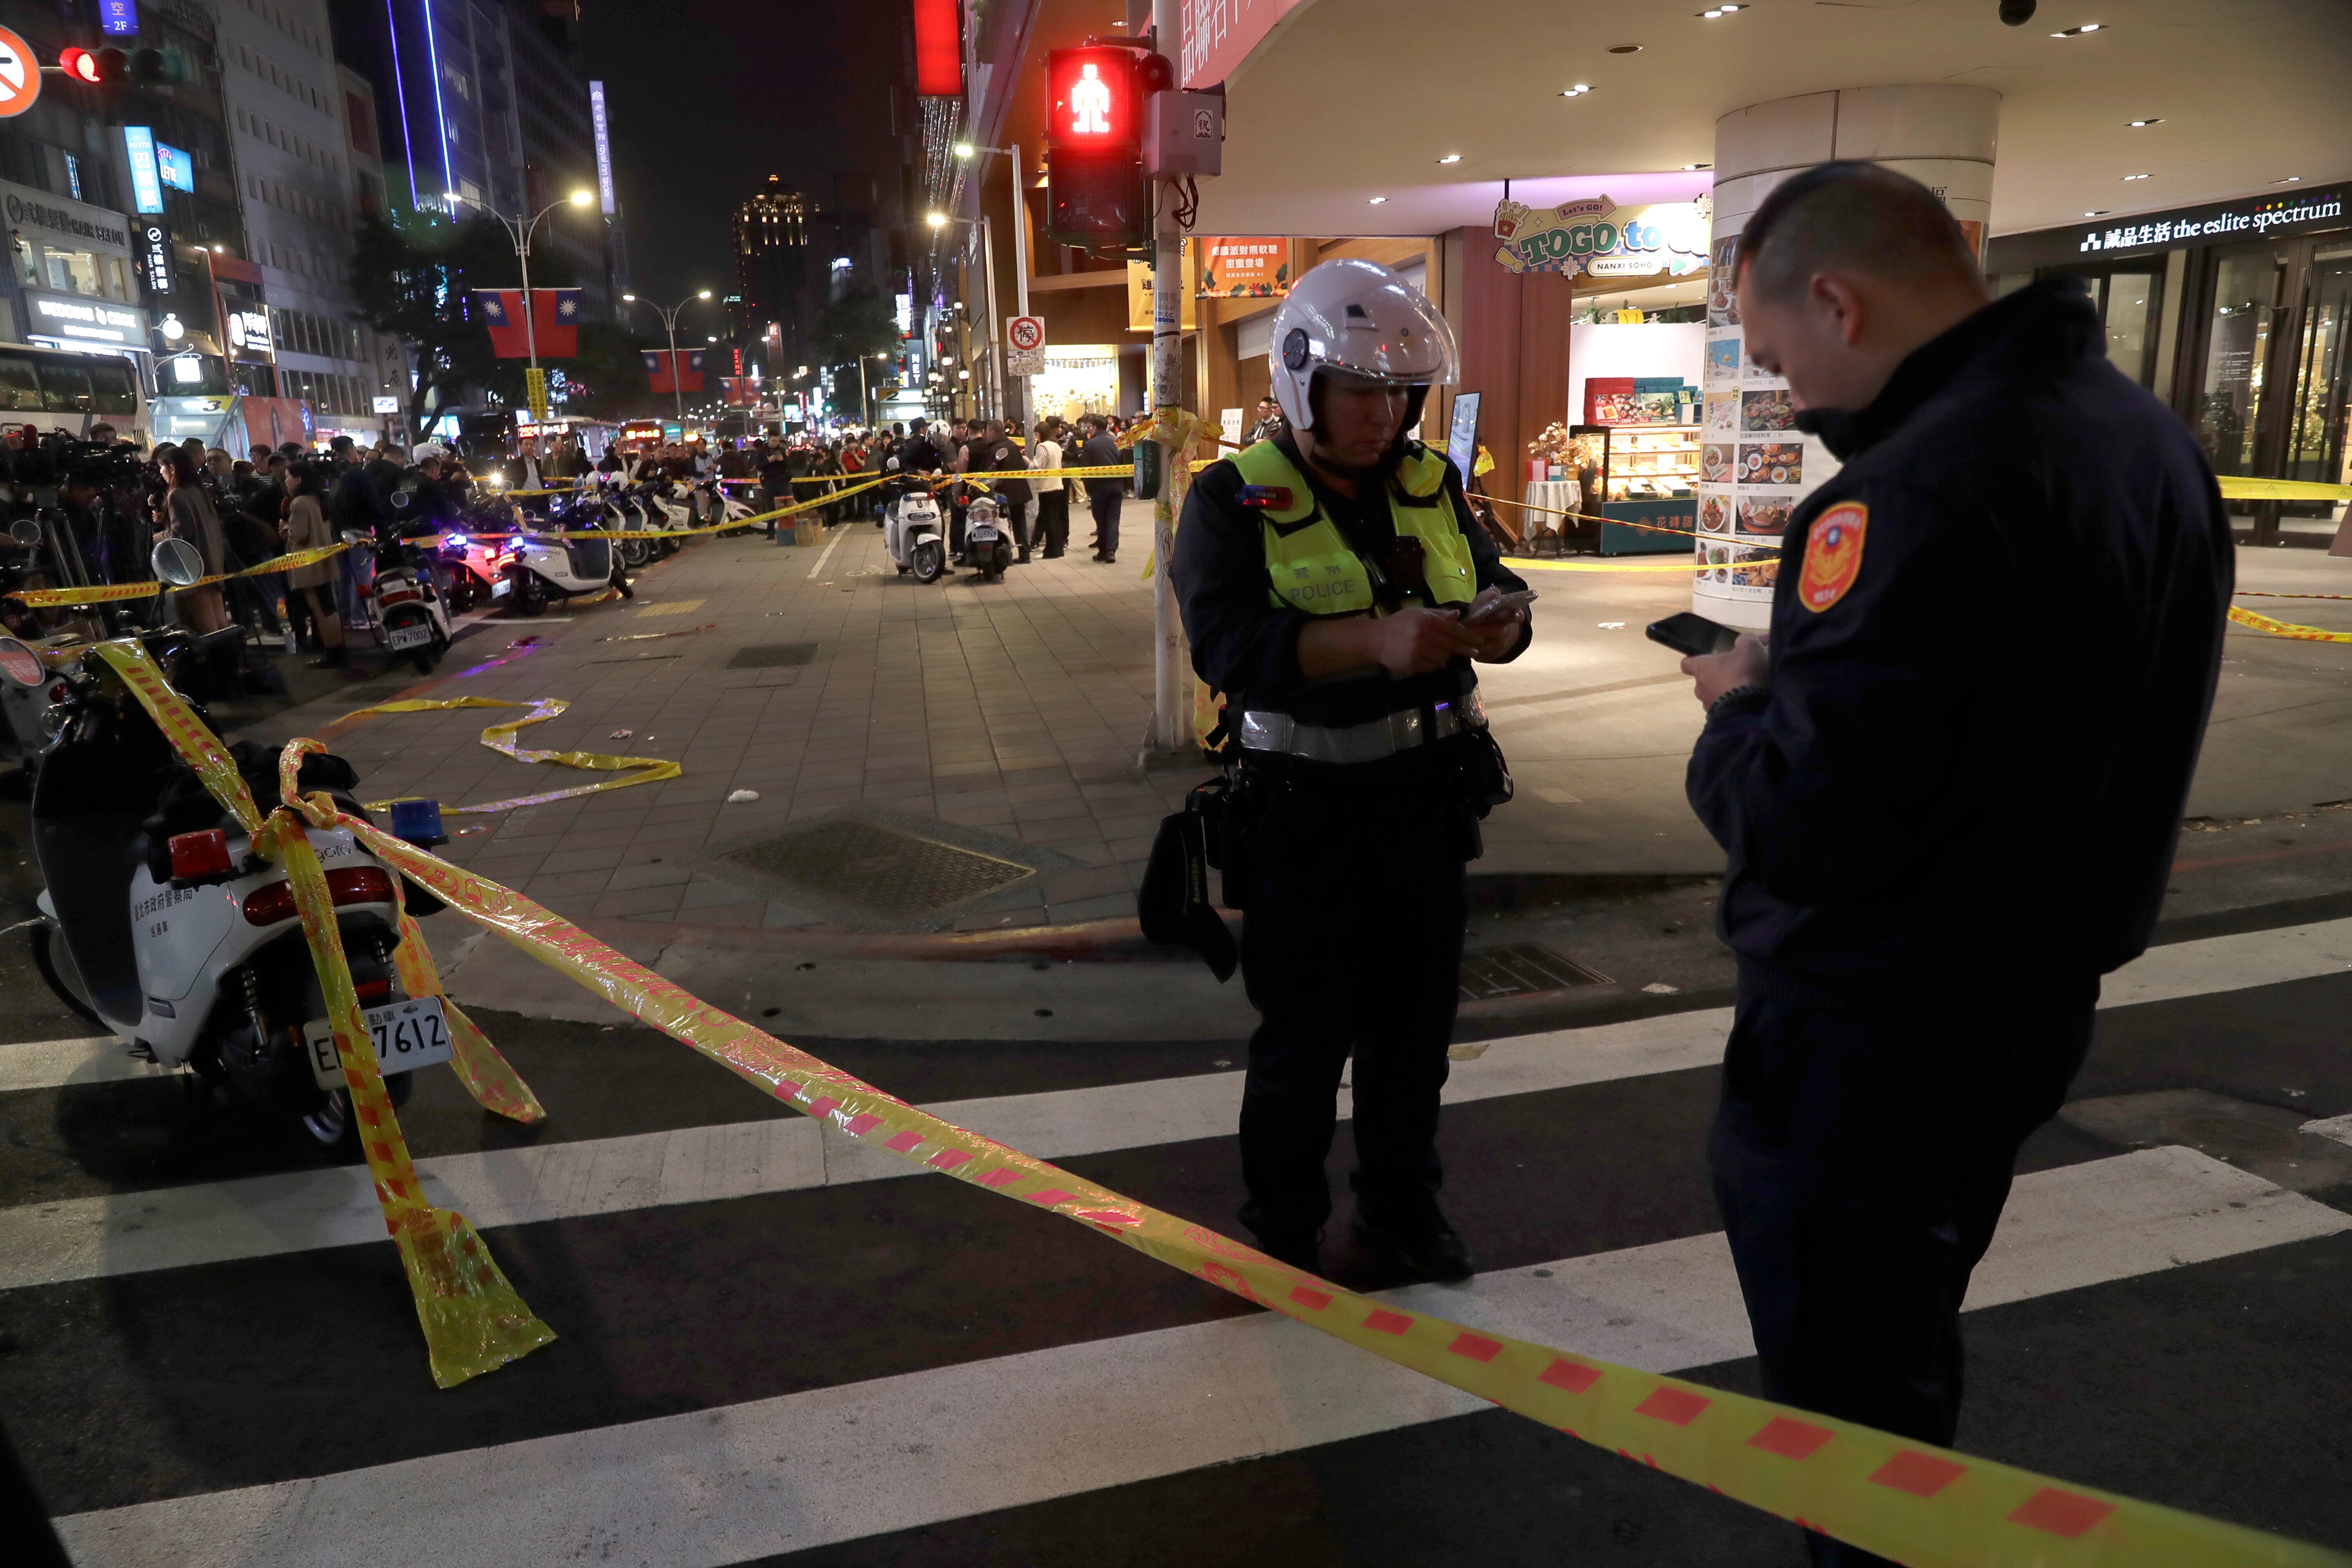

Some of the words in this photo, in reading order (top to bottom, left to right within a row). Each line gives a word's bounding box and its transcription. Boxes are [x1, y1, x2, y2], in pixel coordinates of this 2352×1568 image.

[114, 21, 127, 31] 2F
[1198, 120, 1210, 132] 祝
[599, 144, 608, 163] royal
[160, 164, 177, 183] LETTE
[602, 177, 611, 197] taipei
[1562, 206, 1584, 216] Let's
[2103, 221, 2171, 249] 誠品生活
[2173, 220, 2200, 240] the
[2203, 213, 2249, 235] eslite
[2255, 202, 2341, 233] spectrum
[1520, 222, 1619, 266] TOGO
[1624, 221, 1662, 249] to
[1225, 258, 1264, 269] 甜蜜登場
[1018, 325, 1034, 343] 停
[911, 353, 920, 384] NET
[886, 391, 900, 401] 2
[202, 400, 221, 412] 3
[519, 426, 534, 437] 292
[1656, 515, 1697, 528] 花磚甜
[1290, 579, 1356, 601] POLICE
[363, 1010, 397, 1027] 動車
[313, 1014, 446, 1073] E-7612
